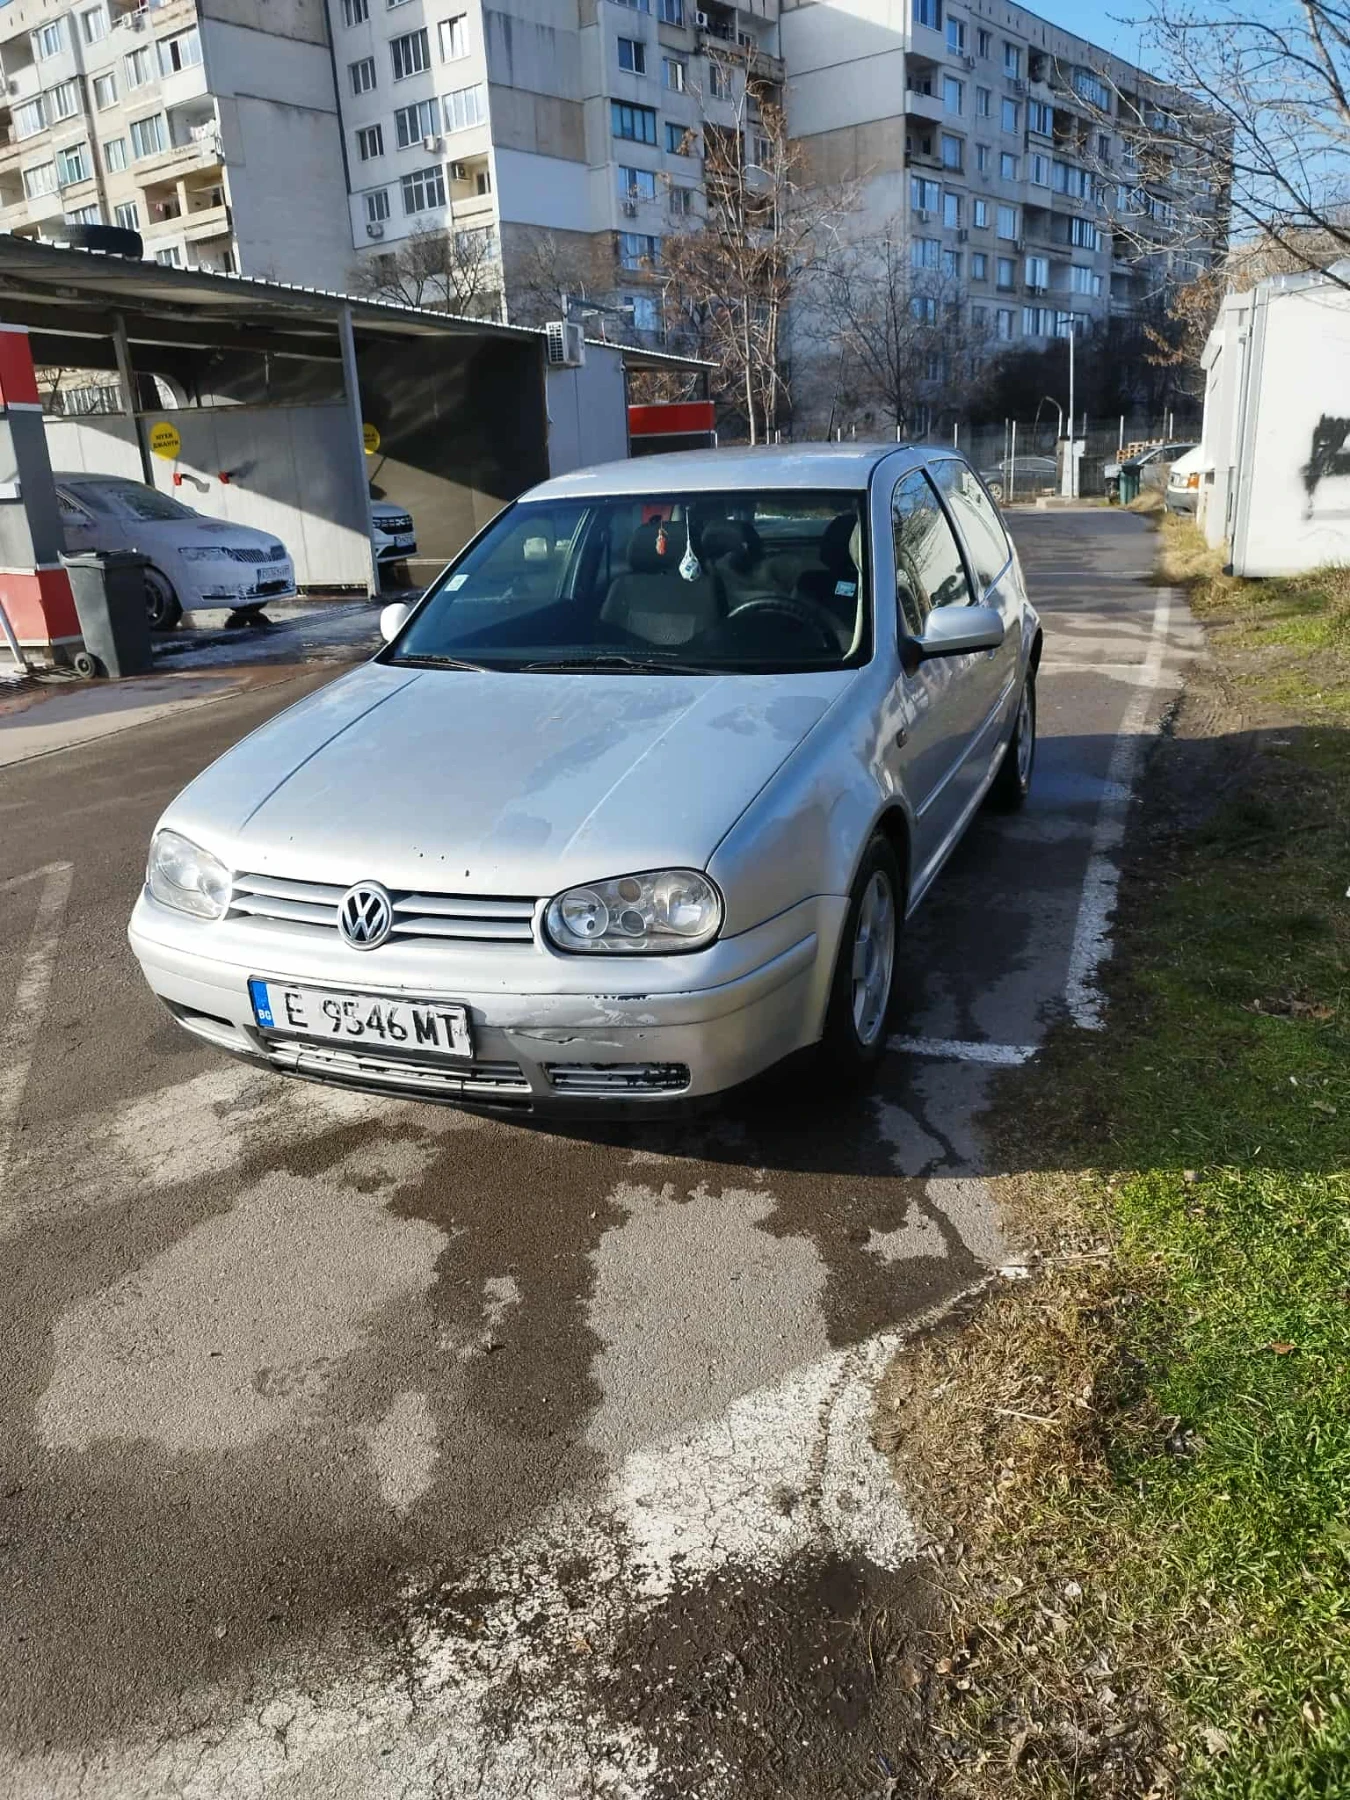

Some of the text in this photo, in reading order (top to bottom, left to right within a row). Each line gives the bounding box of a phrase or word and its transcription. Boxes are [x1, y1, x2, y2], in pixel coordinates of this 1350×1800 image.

[258, 1009, 272, 1021] BG
[284, 992, 459, 1049] E 9546 MT
